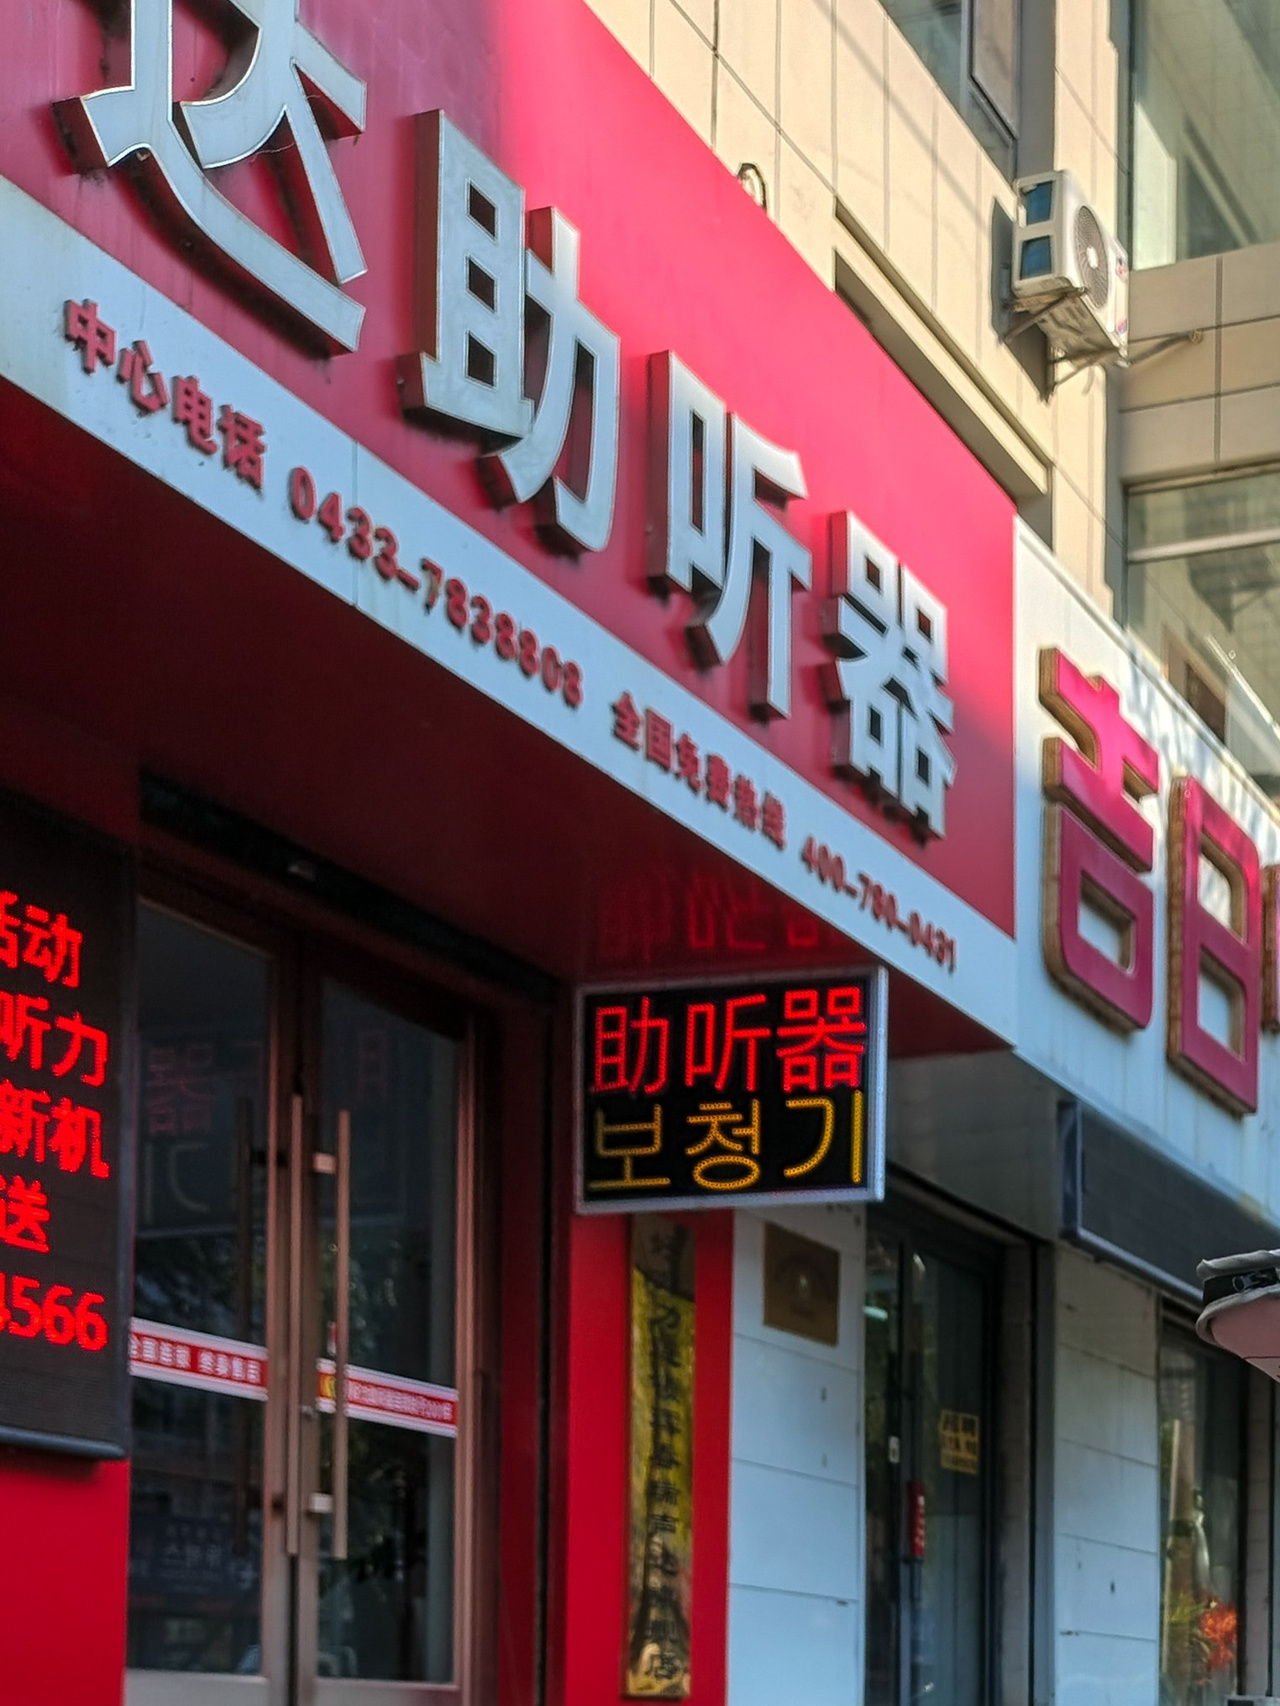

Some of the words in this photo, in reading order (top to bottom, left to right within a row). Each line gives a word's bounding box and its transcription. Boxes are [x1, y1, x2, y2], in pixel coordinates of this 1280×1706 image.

[64, 298, 268, 491] 中心电话
[0, 891, 83, 988] 动
[592, 984, 867, 1095] 助听器
[588, 1089, 863, 1190] 보청기
[0, 1271, 108, 1352] 566
